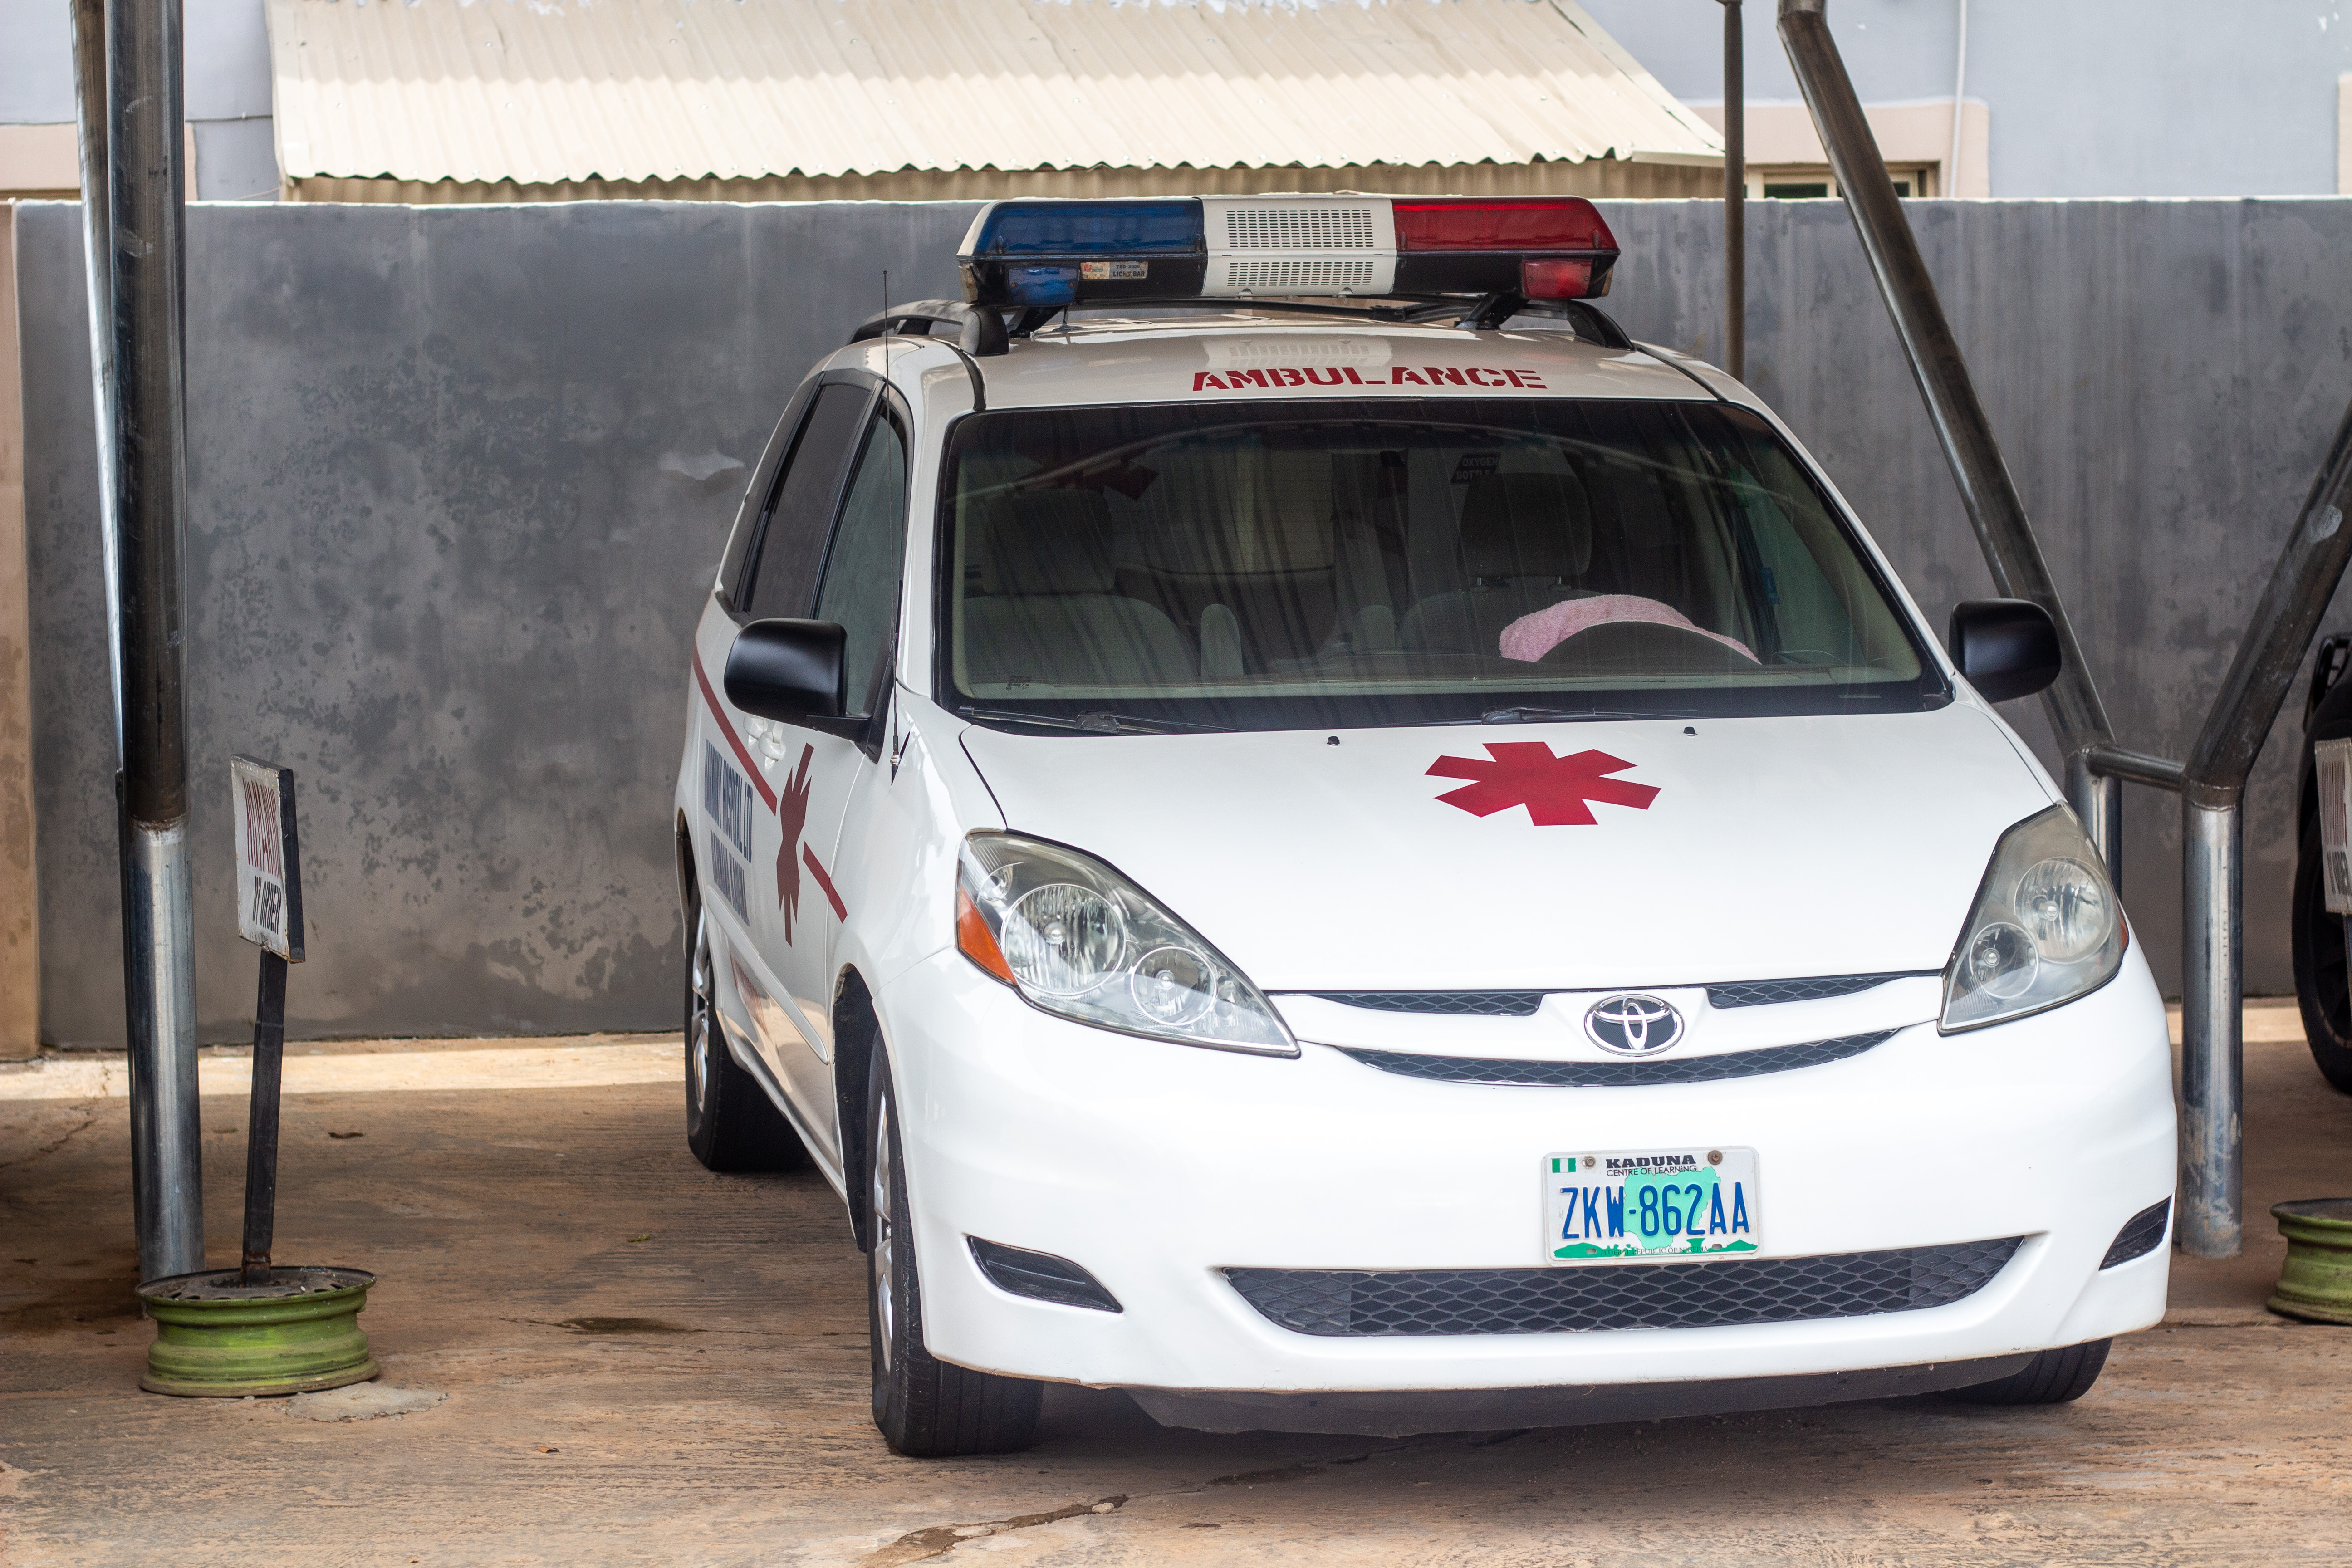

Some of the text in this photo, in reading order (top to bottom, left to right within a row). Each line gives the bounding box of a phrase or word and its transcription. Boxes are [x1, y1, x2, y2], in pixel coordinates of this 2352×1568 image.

[1192, 367, 1548, 392] AMBULANCE
[1462, 457, 1499, 467] OXYGEN
[253, 875, 281, 935] BY ORDER
[1606, 1155, 1696, 1169] KADUNA
[1607, 1165, 1697, 1177] CENTRE OF LEARNING
[1559, 1182, 1749, 1240] ZKW-862AA
